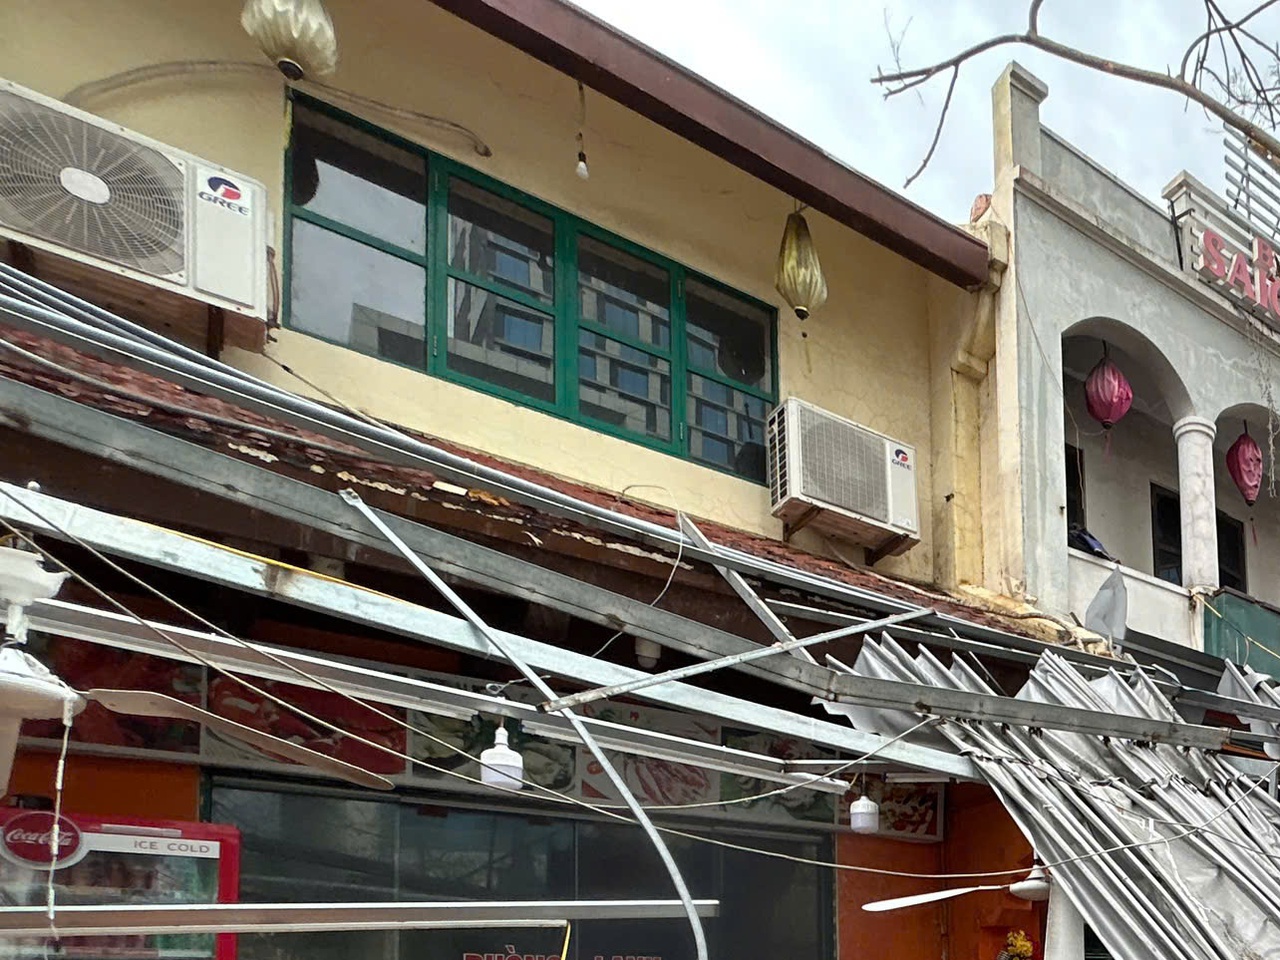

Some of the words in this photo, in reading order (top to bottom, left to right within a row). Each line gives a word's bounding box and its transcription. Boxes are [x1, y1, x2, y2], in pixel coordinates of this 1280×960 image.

[198, 191, 250, 216] GREE
[133, 840, 159, 850] ICE
[167, 842, 210, 854] COLD
